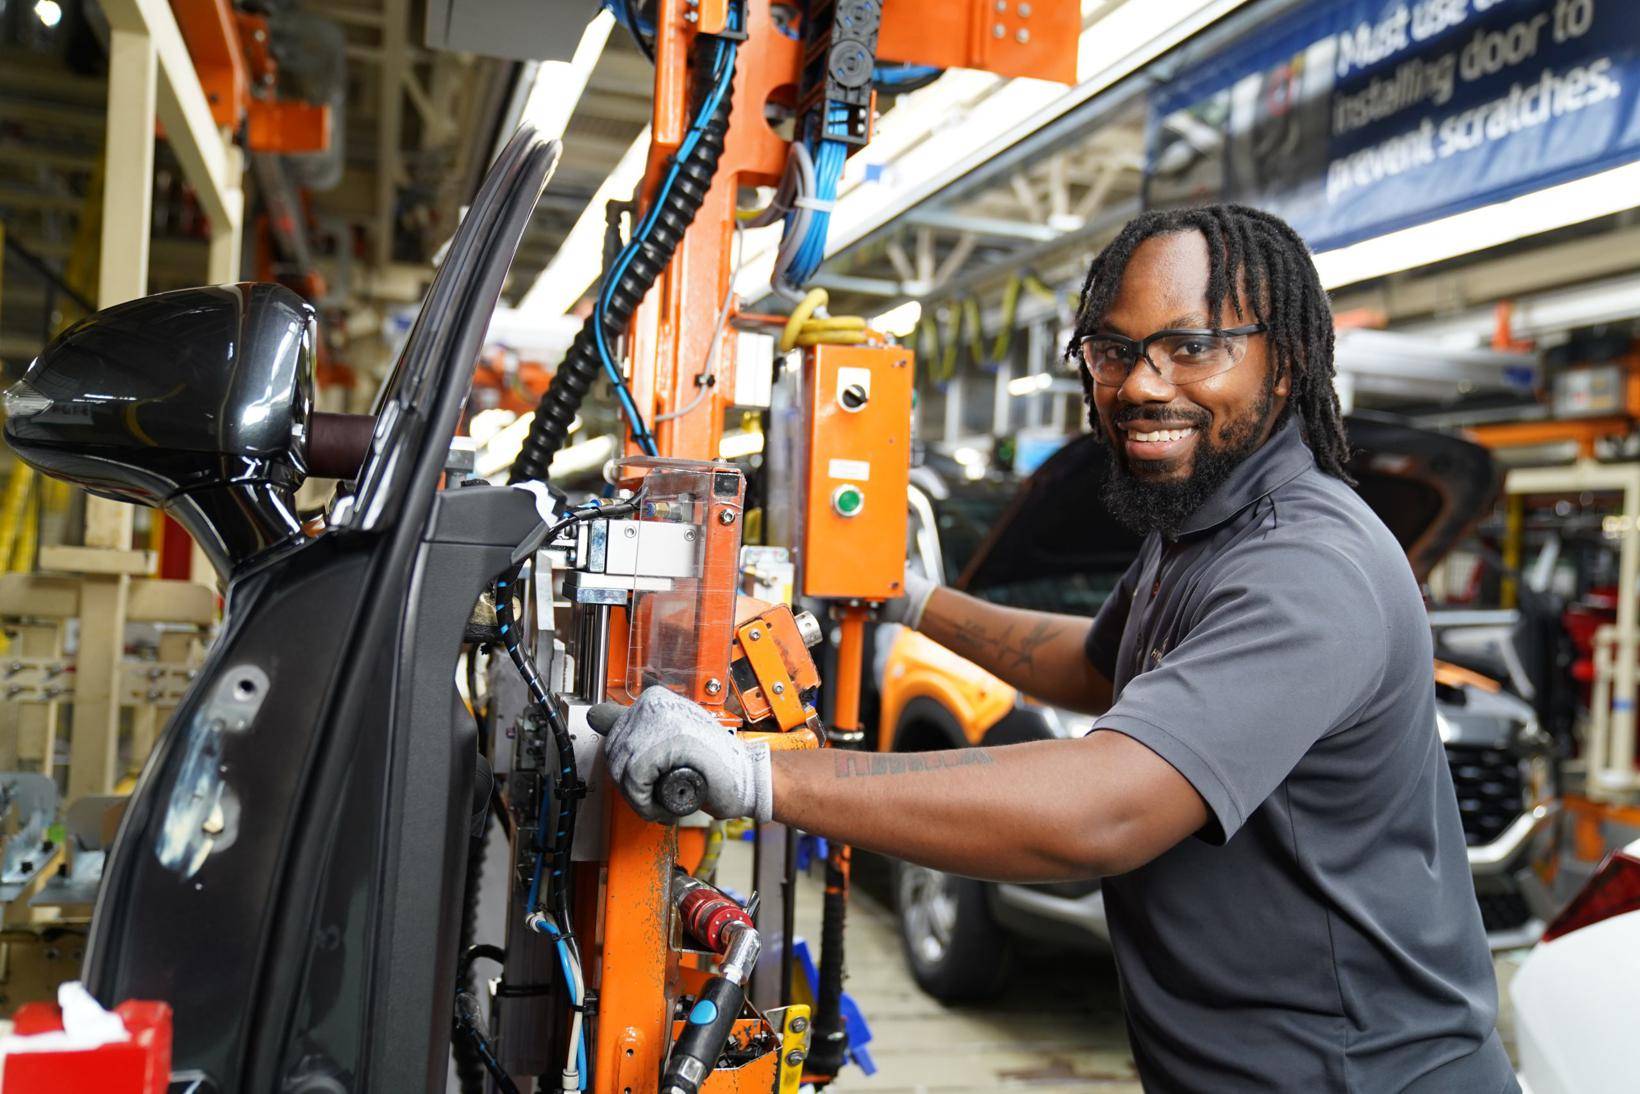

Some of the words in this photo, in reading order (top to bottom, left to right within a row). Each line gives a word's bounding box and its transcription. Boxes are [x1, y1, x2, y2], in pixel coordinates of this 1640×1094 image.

[1334, 53, 1456, 134] installing
[1460, 13, 1549, 80] door
[1554, 0, 1593, 42] to
[1337, 3, 1409, 77] Must
[1412, 0, 1468, 41] use
[1326, 116, 1436, 204] prevent
[1438, 57, 1621, 158] scratches.
